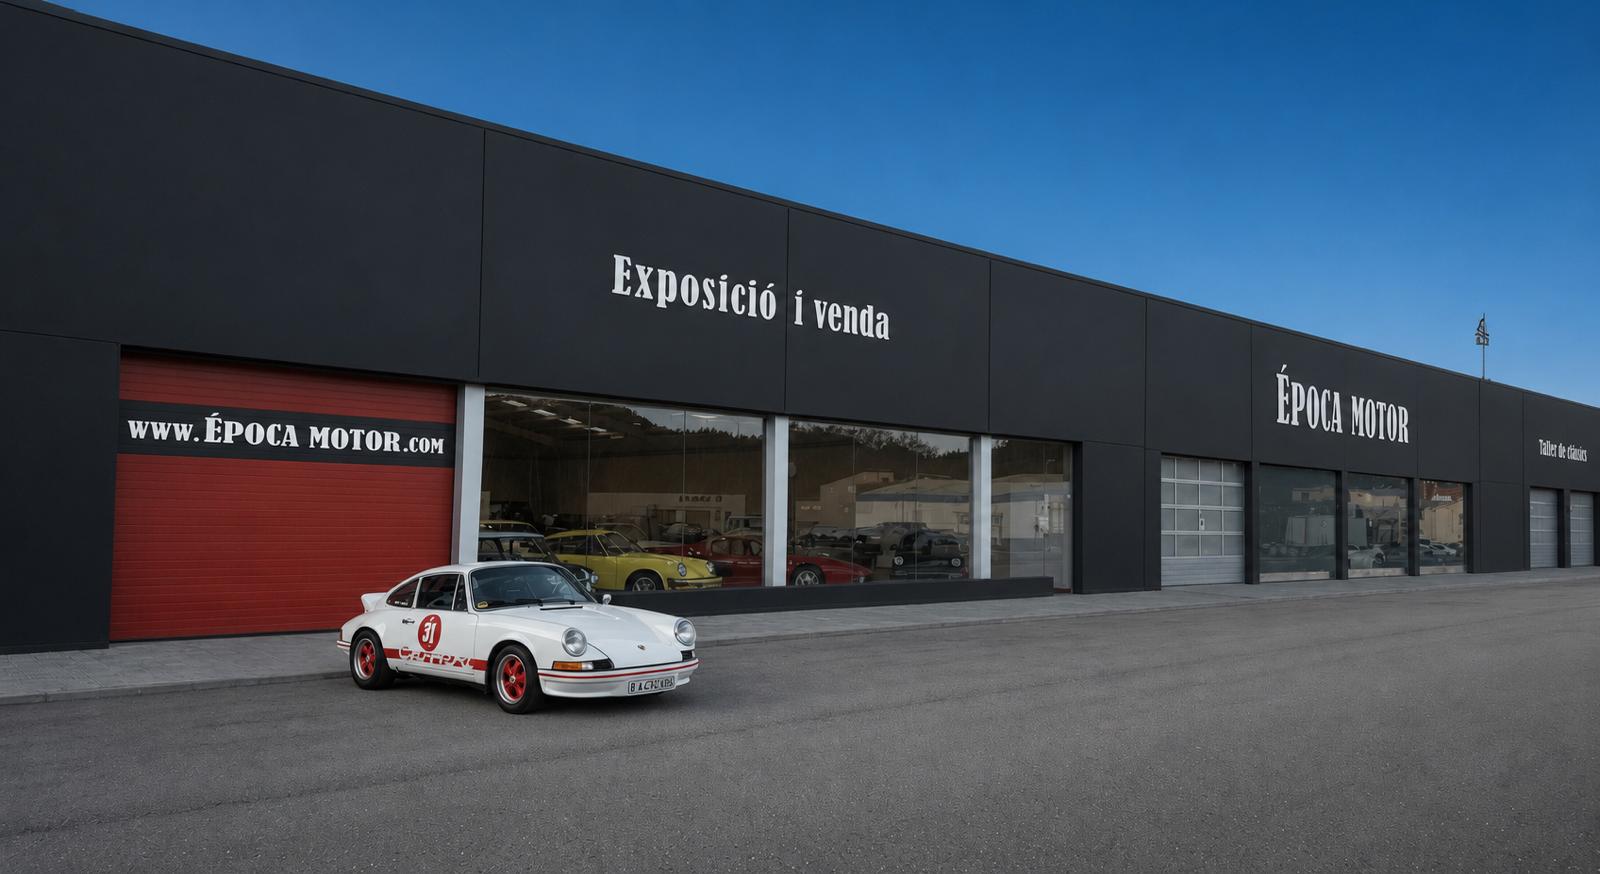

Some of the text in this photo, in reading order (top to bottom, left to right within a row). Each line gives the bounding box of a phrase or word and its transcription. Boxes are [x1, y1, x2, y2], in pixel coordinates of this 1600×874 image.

[611, 252, 890, 341] Exposició i venda
[1275, 363, 1410, 444] ÉPOCA MOTOR
[1538, 438, 1557, 458] Taller
[1558, 442, 1567, 459] de
[422, 621, 437, 644] 31
